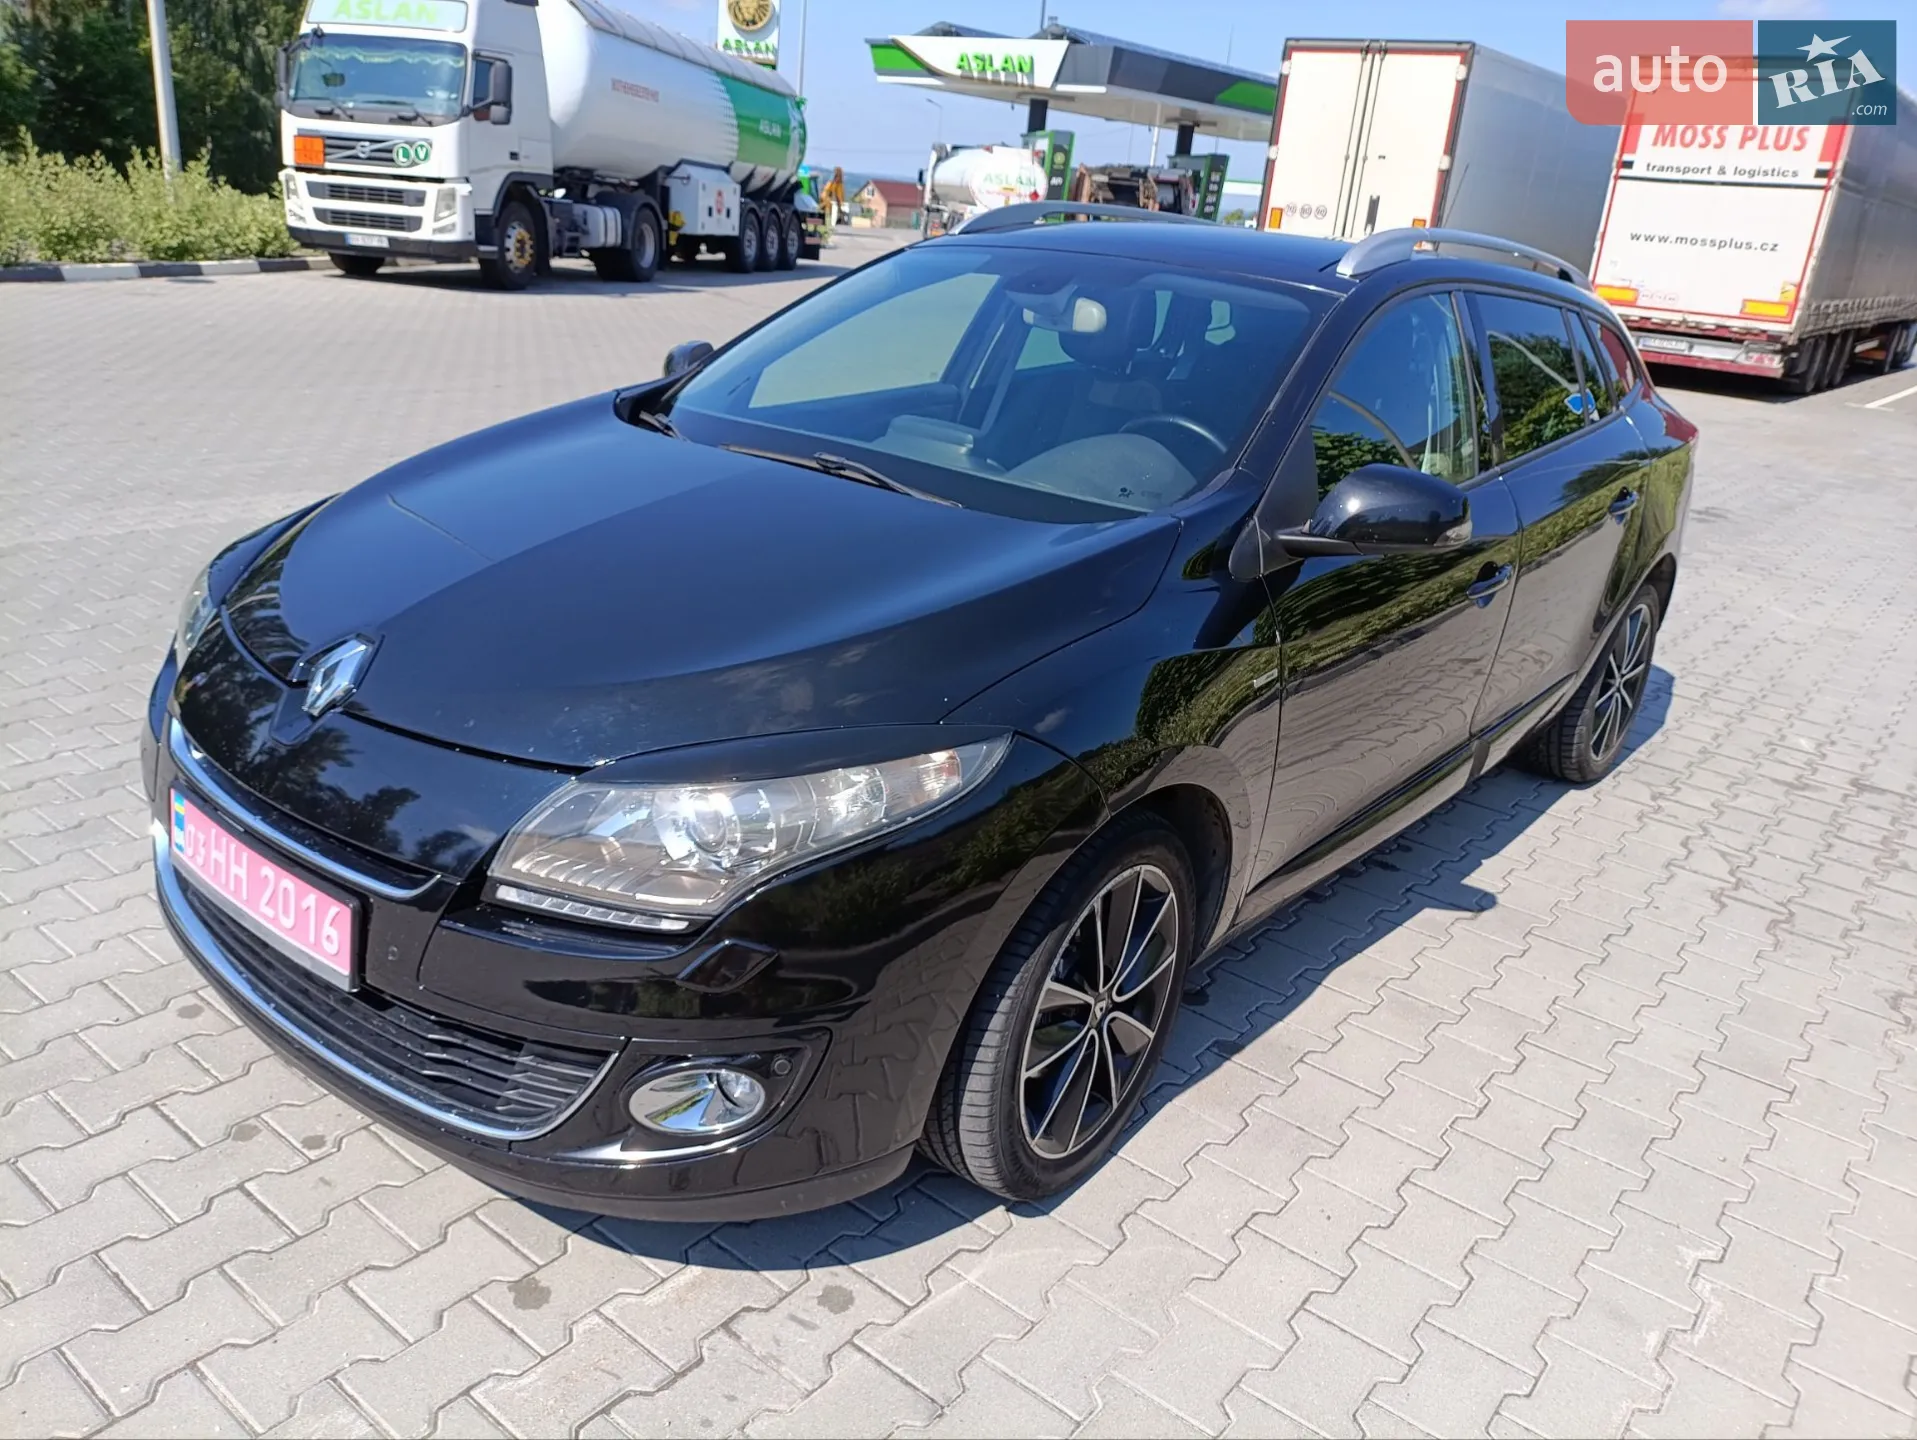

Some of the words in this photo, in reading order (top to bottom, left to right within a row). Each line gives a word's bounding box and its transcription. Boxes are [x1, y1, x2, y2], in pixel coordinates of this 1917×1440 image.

[333, 0, 438, 23] ASLAN
[723, 38, 776, 55] ASLAN
[956, 52, 1034, 74] ASLAN
[1651, 124, 1728, 150] MOSS
[1738, 125, 1810, 152] PLUS
[982, 173, 1036, 188] ASLAN
[1646, 162, 1713, 177] transport
[1717, 165, 1727, 176] &
[1733, 166, 1800, 179] logistics
[1629, 230, 1780, 253] www.mossplus.cz
[259, 866, 341, 956] 2016
